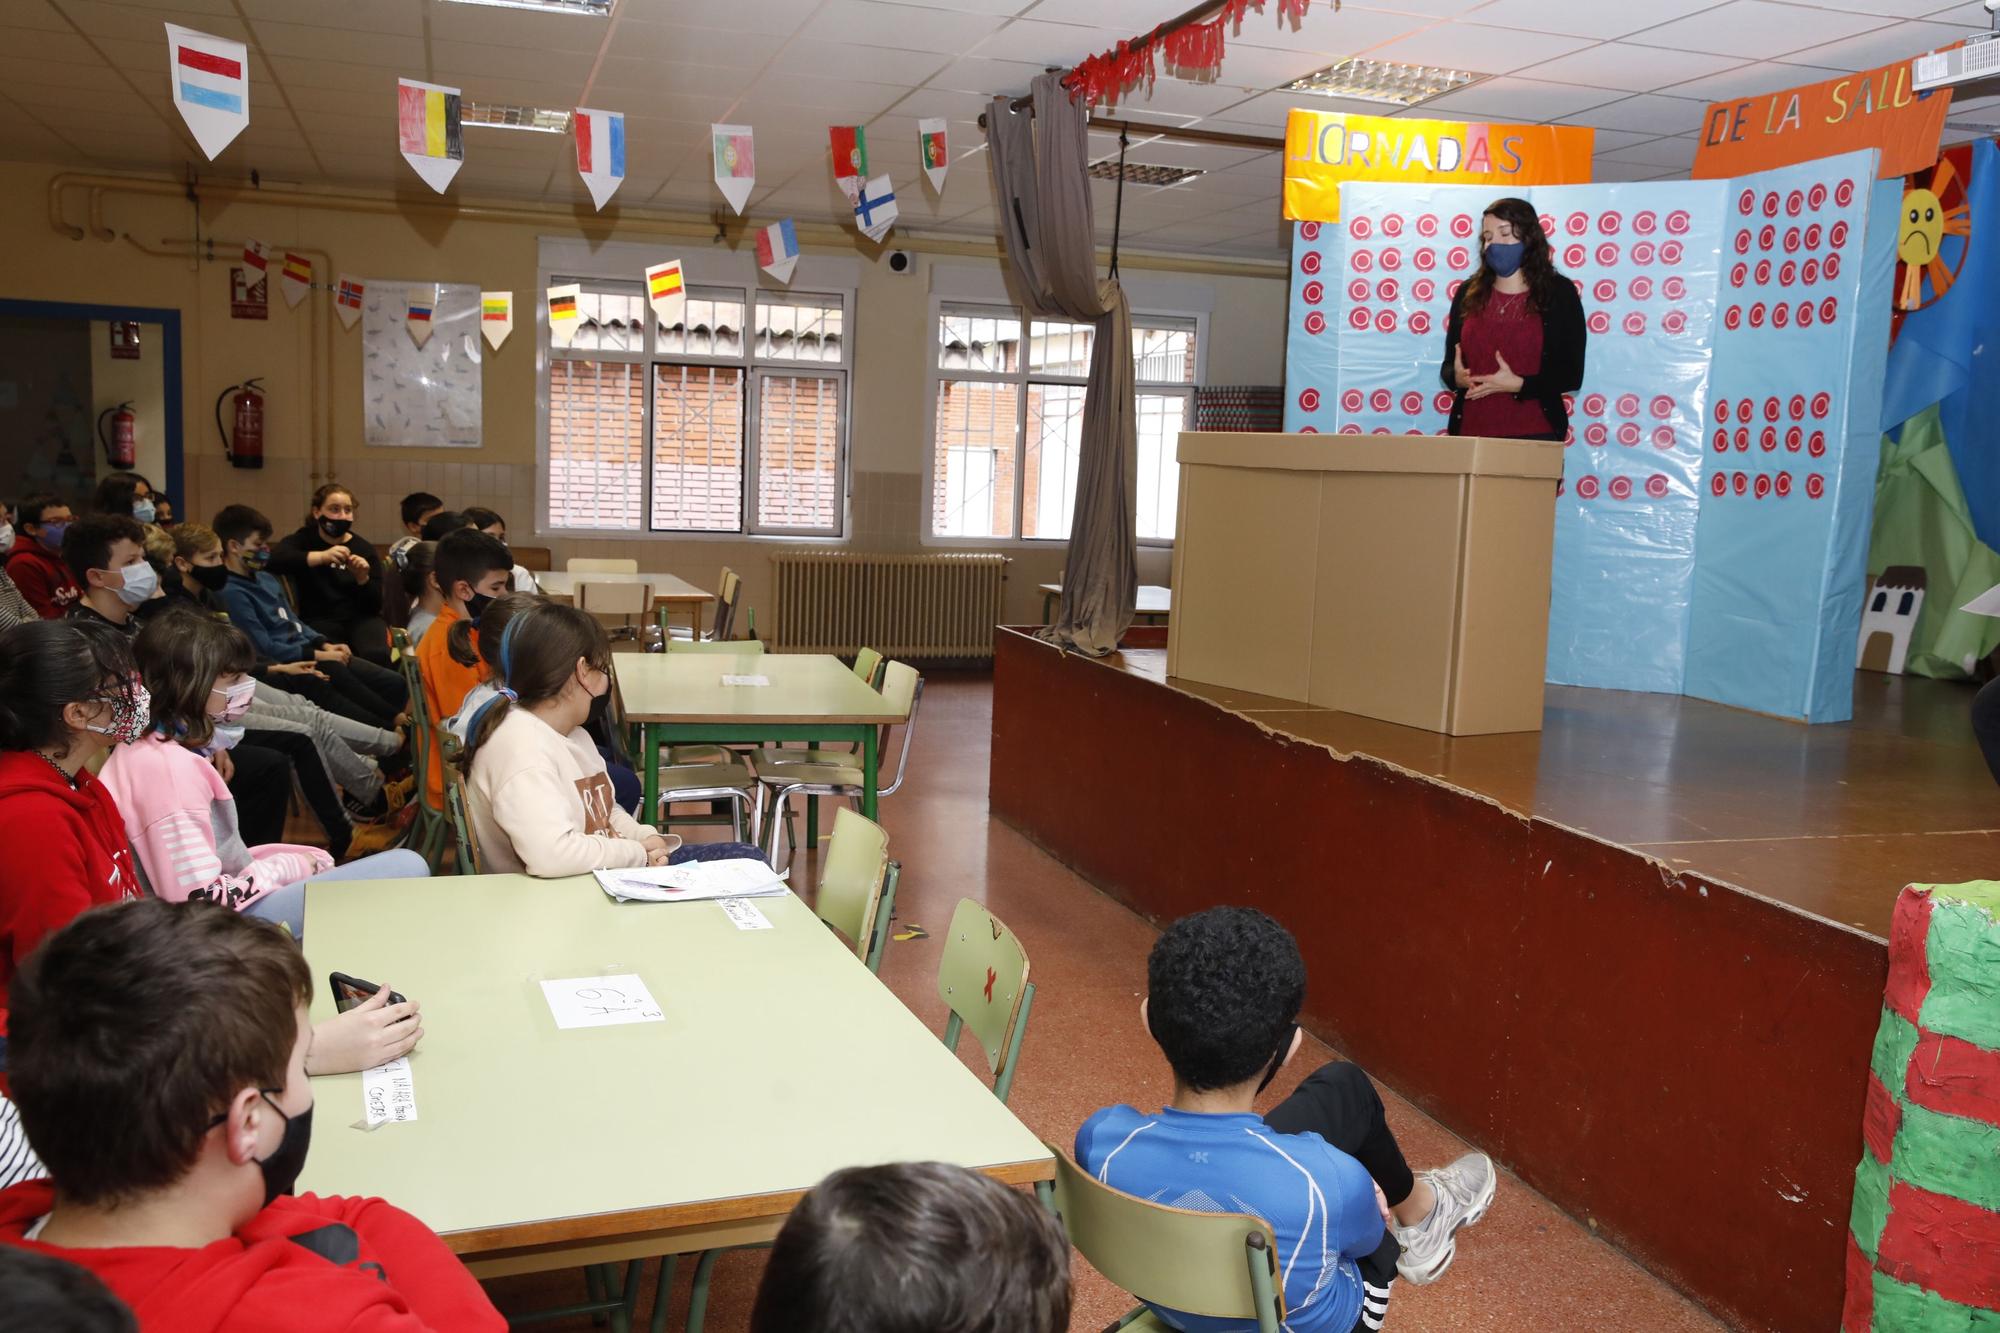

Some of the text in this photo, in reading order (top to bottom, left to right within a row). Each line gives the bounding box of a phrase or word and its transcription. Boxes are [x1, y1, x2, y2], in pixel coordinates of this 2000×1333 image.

[1705, 102, 1751, 147] DE
[1763, 93, 1801, 135] LA
[1825, 66, 1936, 124] SALU
[1289, 119, 1524, 174] JORNADAS
